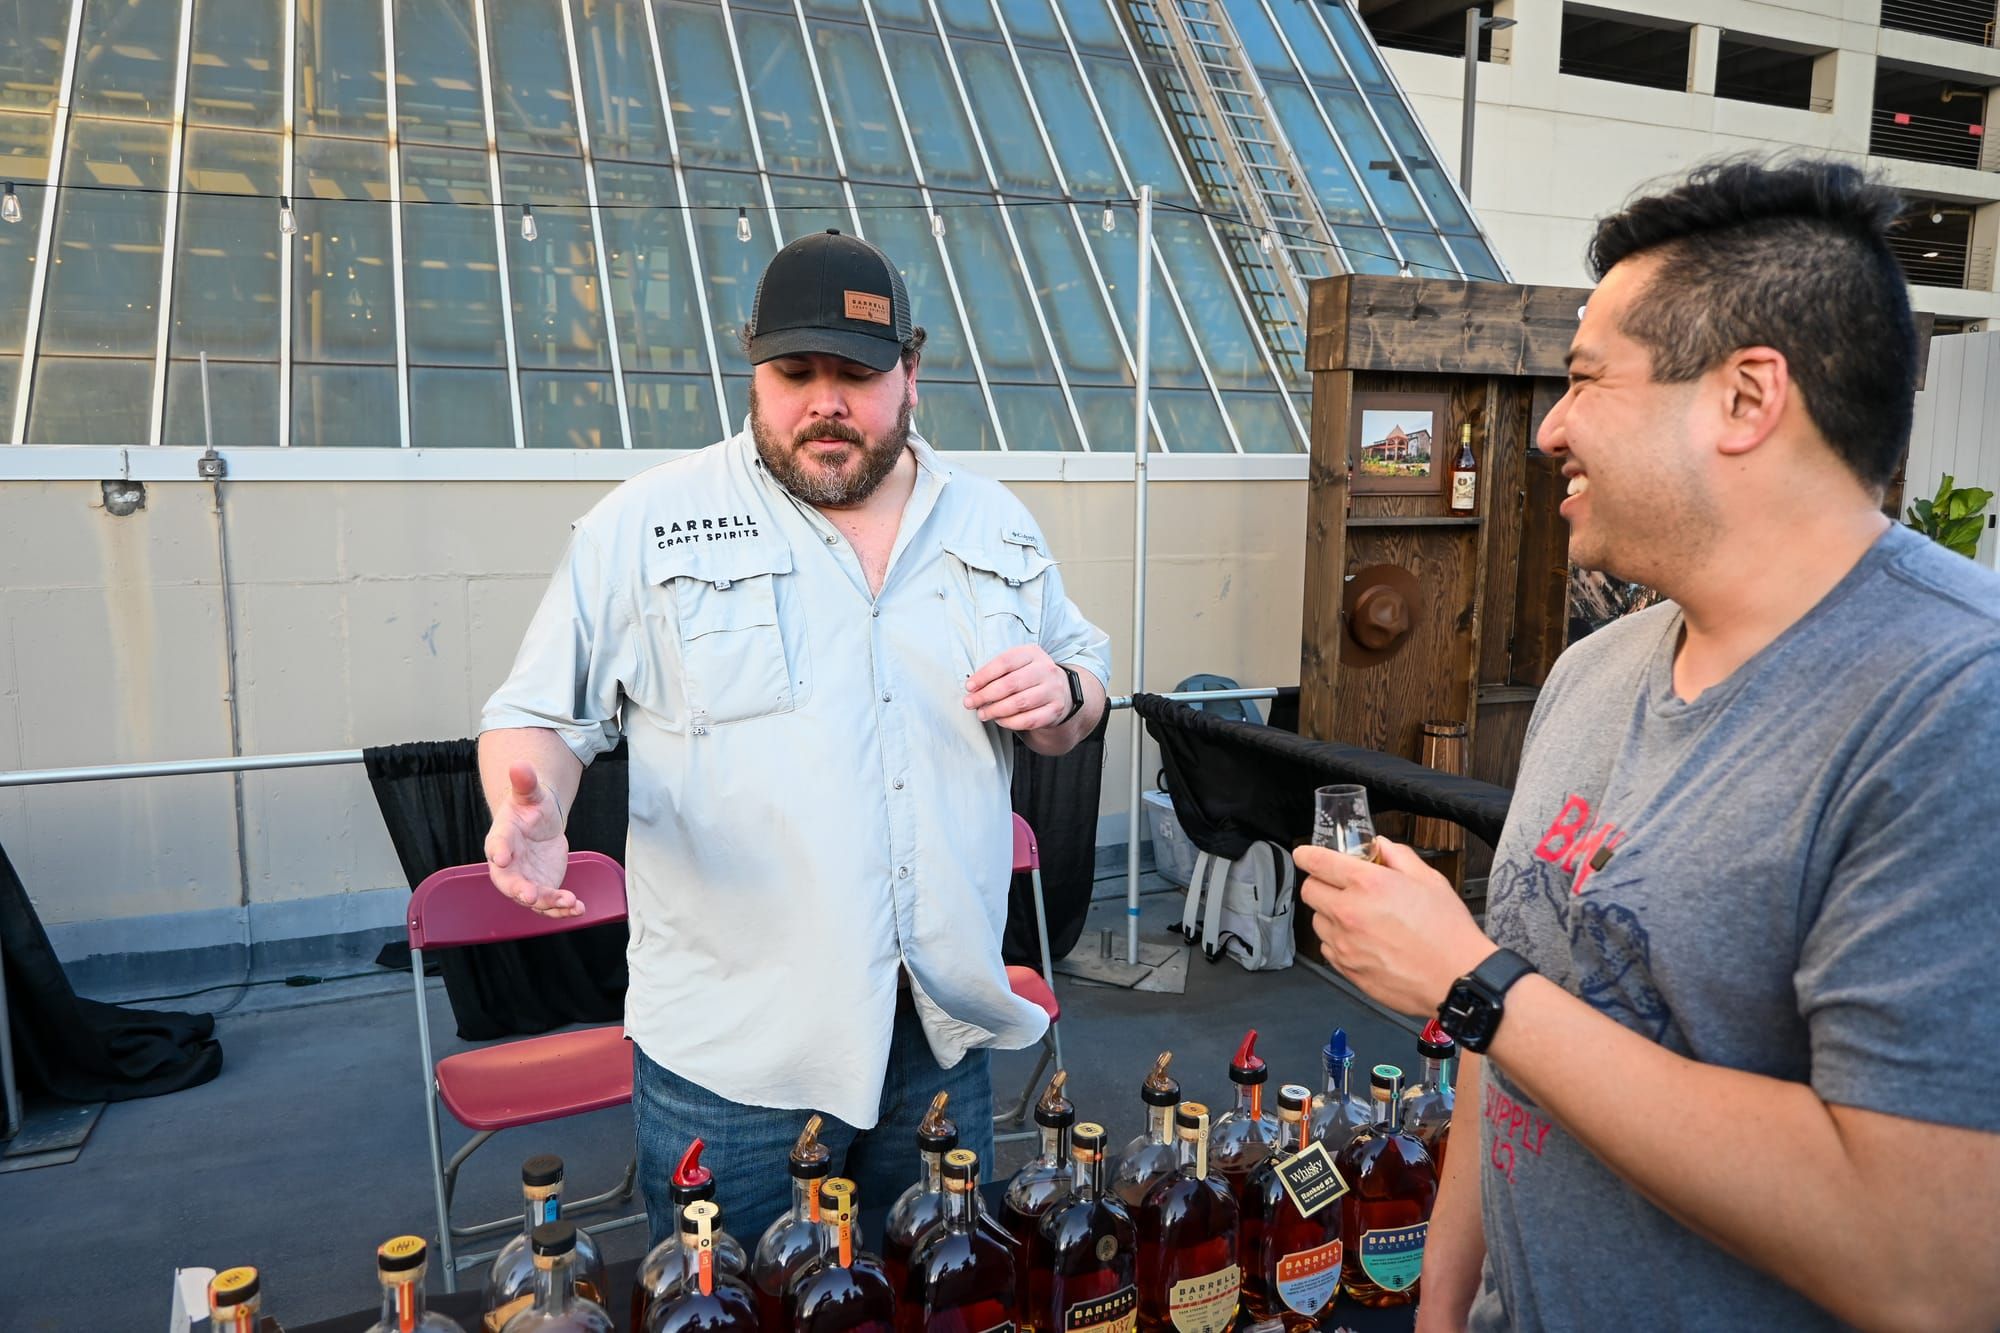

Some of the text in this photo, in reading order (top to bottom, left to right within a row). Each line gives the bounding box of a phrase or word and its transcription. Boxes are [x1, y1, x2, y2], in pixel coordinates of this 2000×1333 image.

[852, 299, 885, 310] BARRELL
[654, 515, 757, 538] BARRELL
[657, 529, 759, 549] CRAFT SPIRITS
[1290, 1159, 1323, 1183] Whisky
[1286, 1247, 1339, 1270] BARRELL
[1179, 1273, 1235, 1296] BARRELL
[1074, 1293, 1133, 1319] BARRELL
